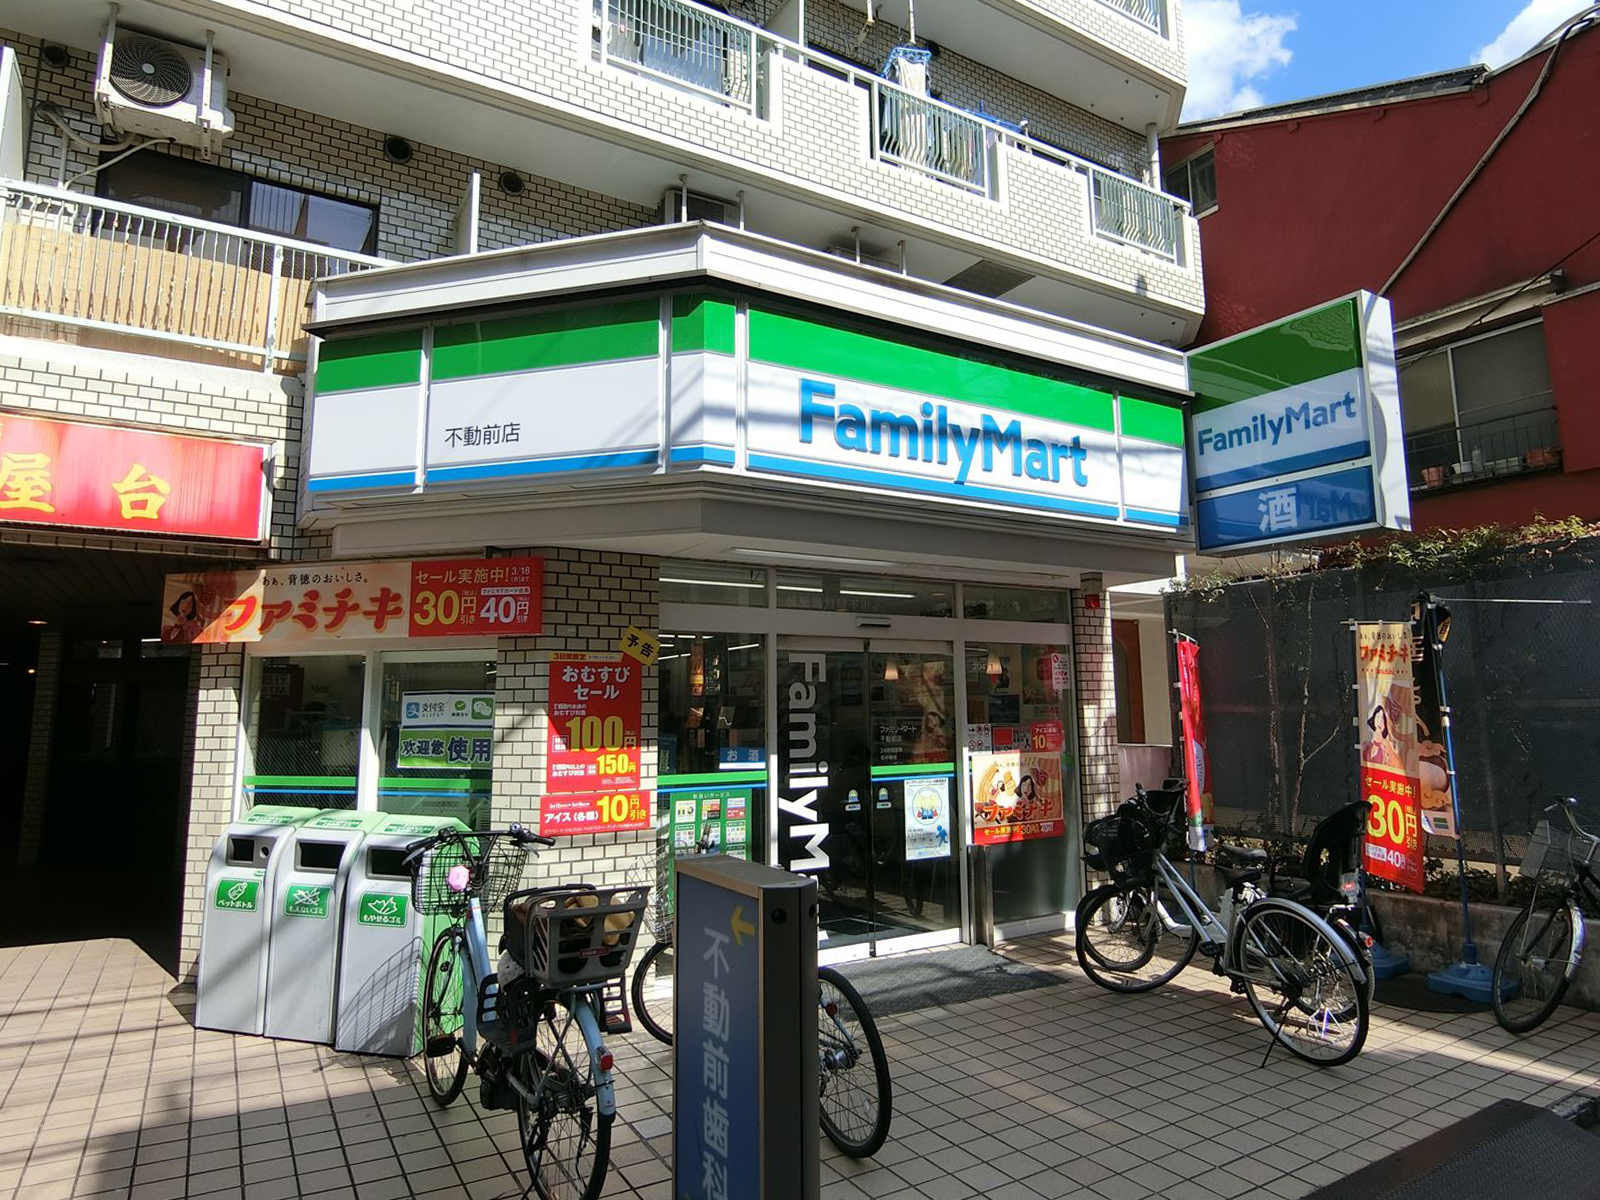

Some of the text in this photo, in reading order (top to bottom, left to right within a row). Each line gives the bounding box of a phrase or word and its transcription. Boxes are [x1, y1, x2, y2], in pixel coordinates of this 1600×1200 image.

[445, 422, 521, 448] 不動前店
[799, 378, 1088, 487] FamilyMart
[1198, 392, 1356, 455] FamilyMart
[1257, 487, 1298, 532] 酒
[415, 567, 509, 584] セール実施中!
[225, 587, 404, 635] ファミチキ
[627, 633, 654, 658] 予告
[1359, 643, 1409, 663] ファミチキ
[562, 665, 631, 683] おむすび
[574, 684, 620, 700] セール
[983, 800, 1053, 822] ファミチキ
[218, 900, 253, 909] ペットボトル
[703, 927, 730, 1200] 不動前歯科
